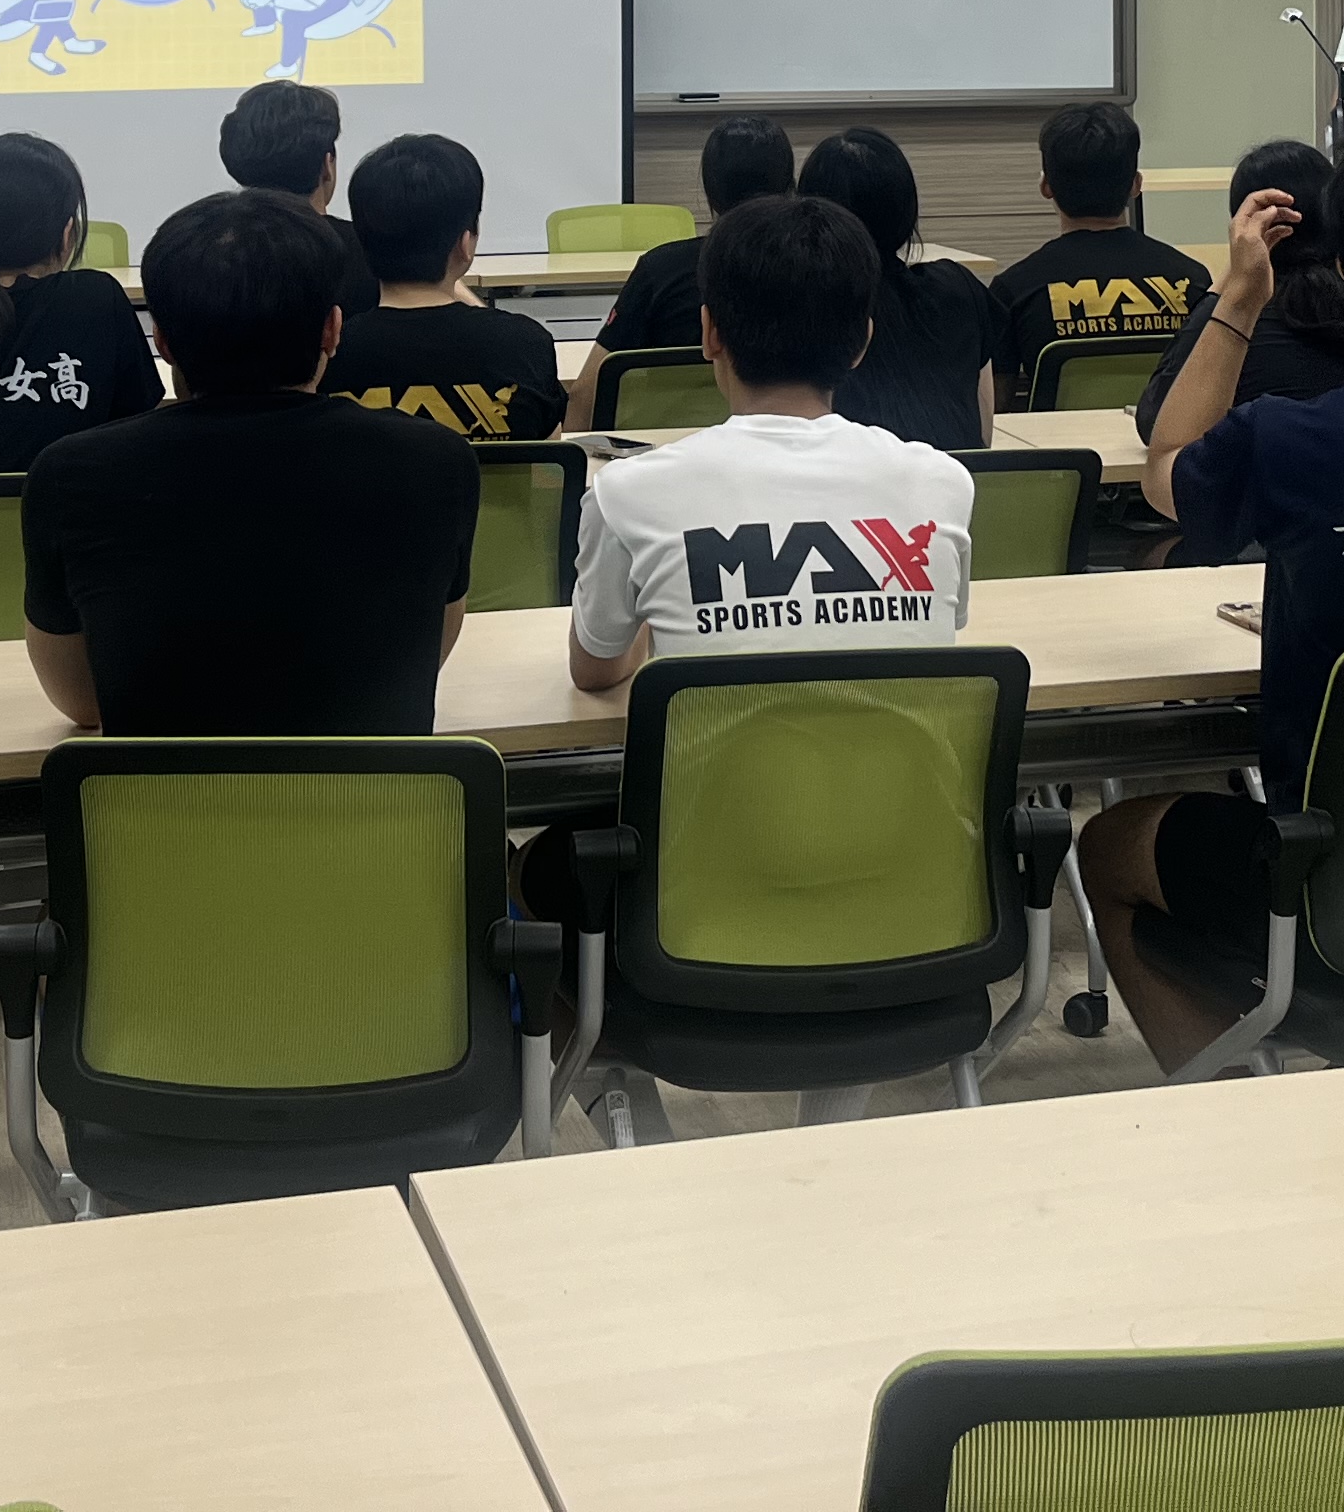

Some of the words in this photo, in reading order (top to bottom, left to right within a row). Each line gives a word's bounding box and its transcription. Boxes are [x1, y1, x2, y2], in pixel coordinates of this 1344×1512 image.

[1047, 276, 1190, 321] MAX
[1057, 318, 1117, 336] SPORTS
[683, 518, 937, 605] MAX
[697, 600, 803, 634] SPORTS
[814, 595, 933, 625] ACADEMY
